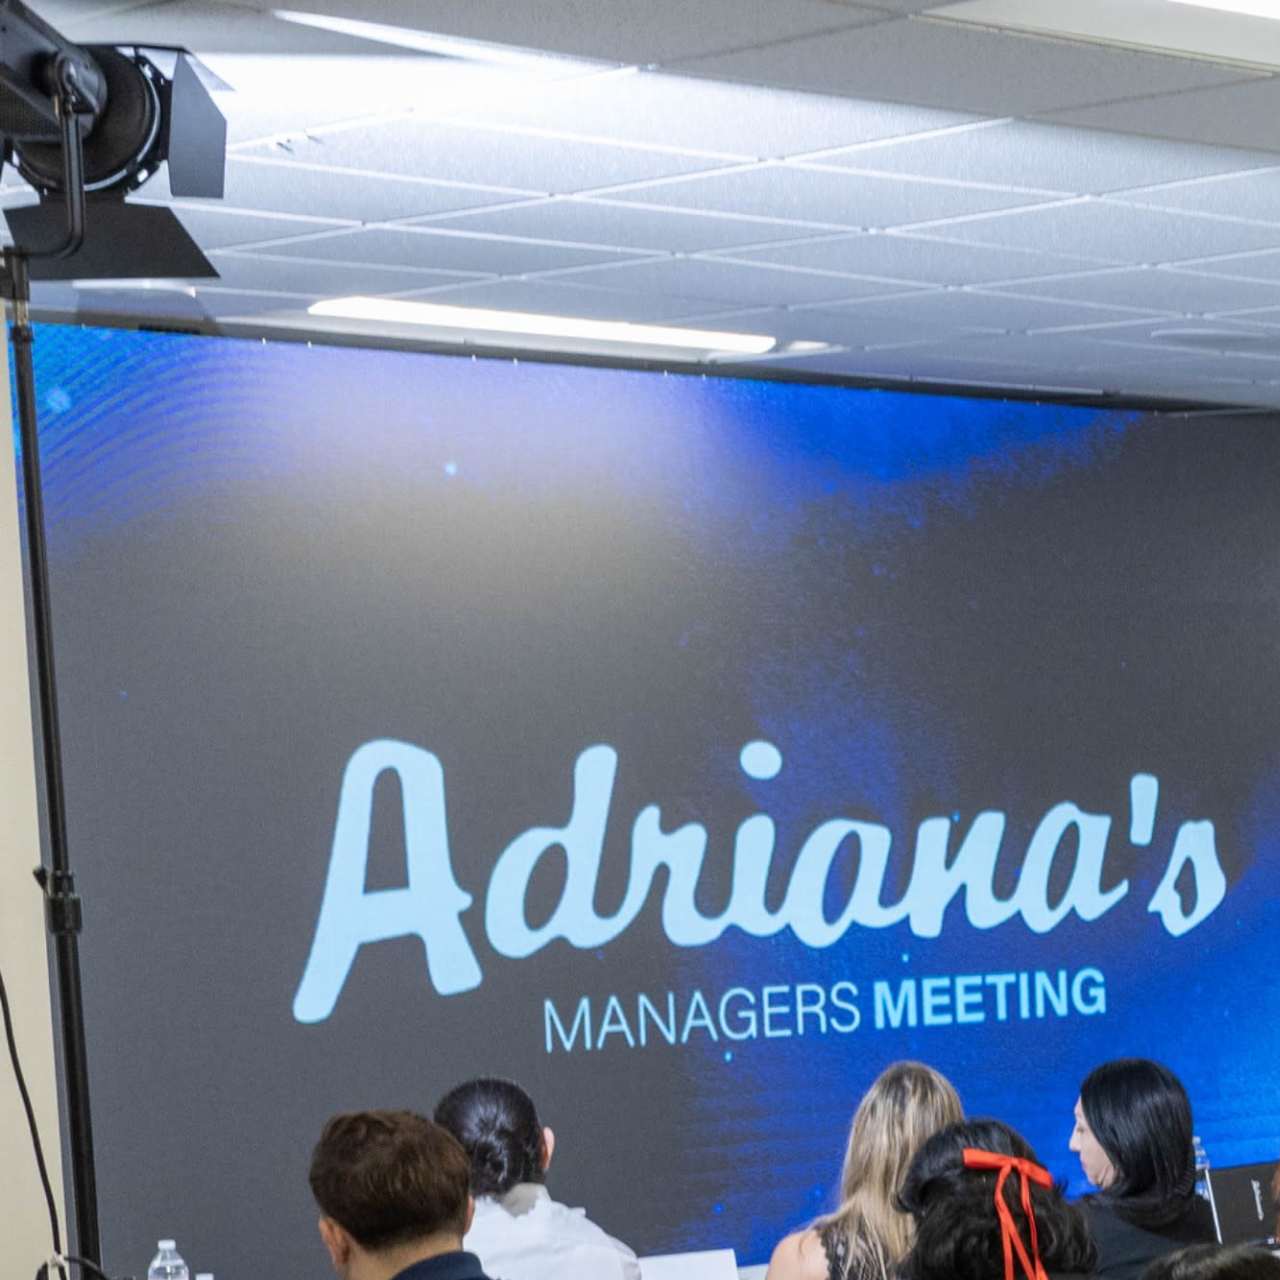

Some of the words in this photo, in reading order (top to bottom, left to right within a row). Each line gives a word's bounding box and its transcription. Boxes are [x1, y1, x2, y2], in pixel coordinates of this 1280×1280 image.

[292, 737, 1227, 1023] Adriana's
[543, 982, 862, 1053] MANAGERS
[872, 968, 1107, 1031] MEETING
